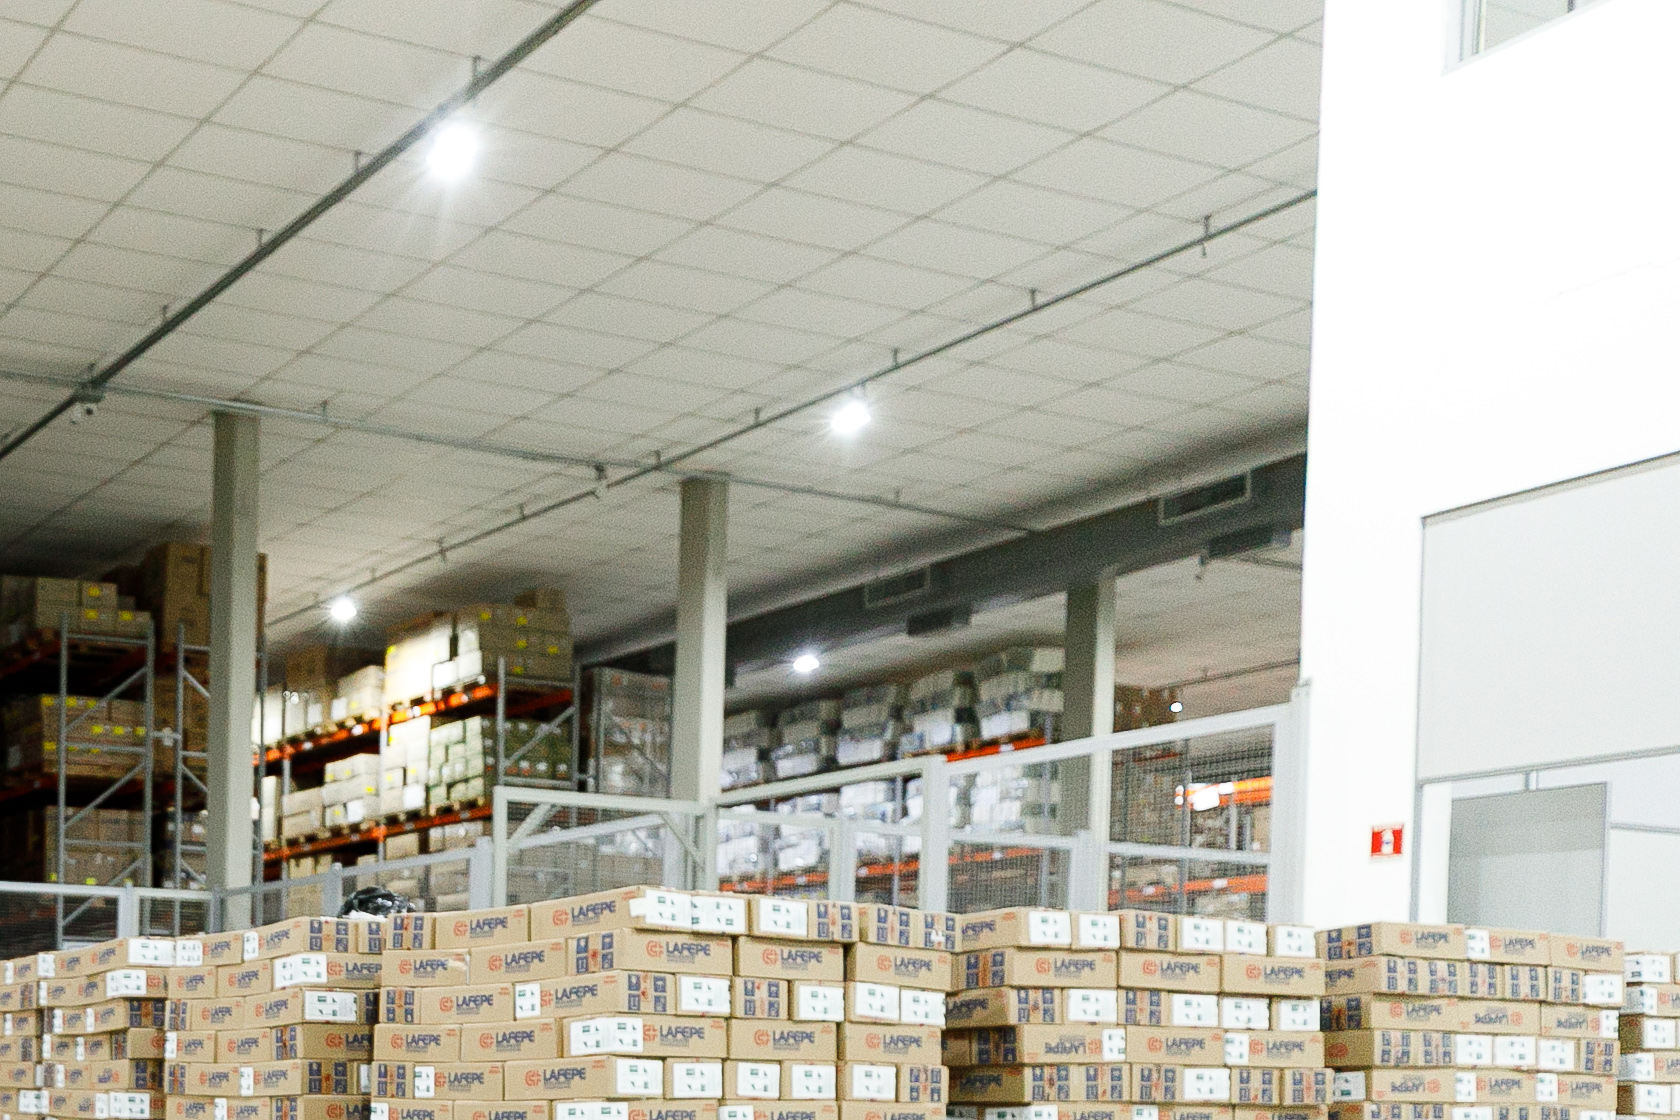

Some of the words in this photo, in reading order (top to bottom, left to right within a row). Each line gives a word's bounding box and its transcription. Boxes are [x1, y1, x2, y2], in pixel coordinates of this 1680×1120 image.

[572, 900, 616, 920] LAFEPE
[470, 916, 508, 932] LAFEPE
[666, 941, 711, 957] LAFEPE
[781, 949, 823, 963] LAFEPE
[894, 956, 932, 971] LAFEPE
[1054, 958, 1096, 972] LAFEPE
[1160, 961, 1200, 974] LAFEPE
[772, 1030, 815, 1043] LAFEPE
